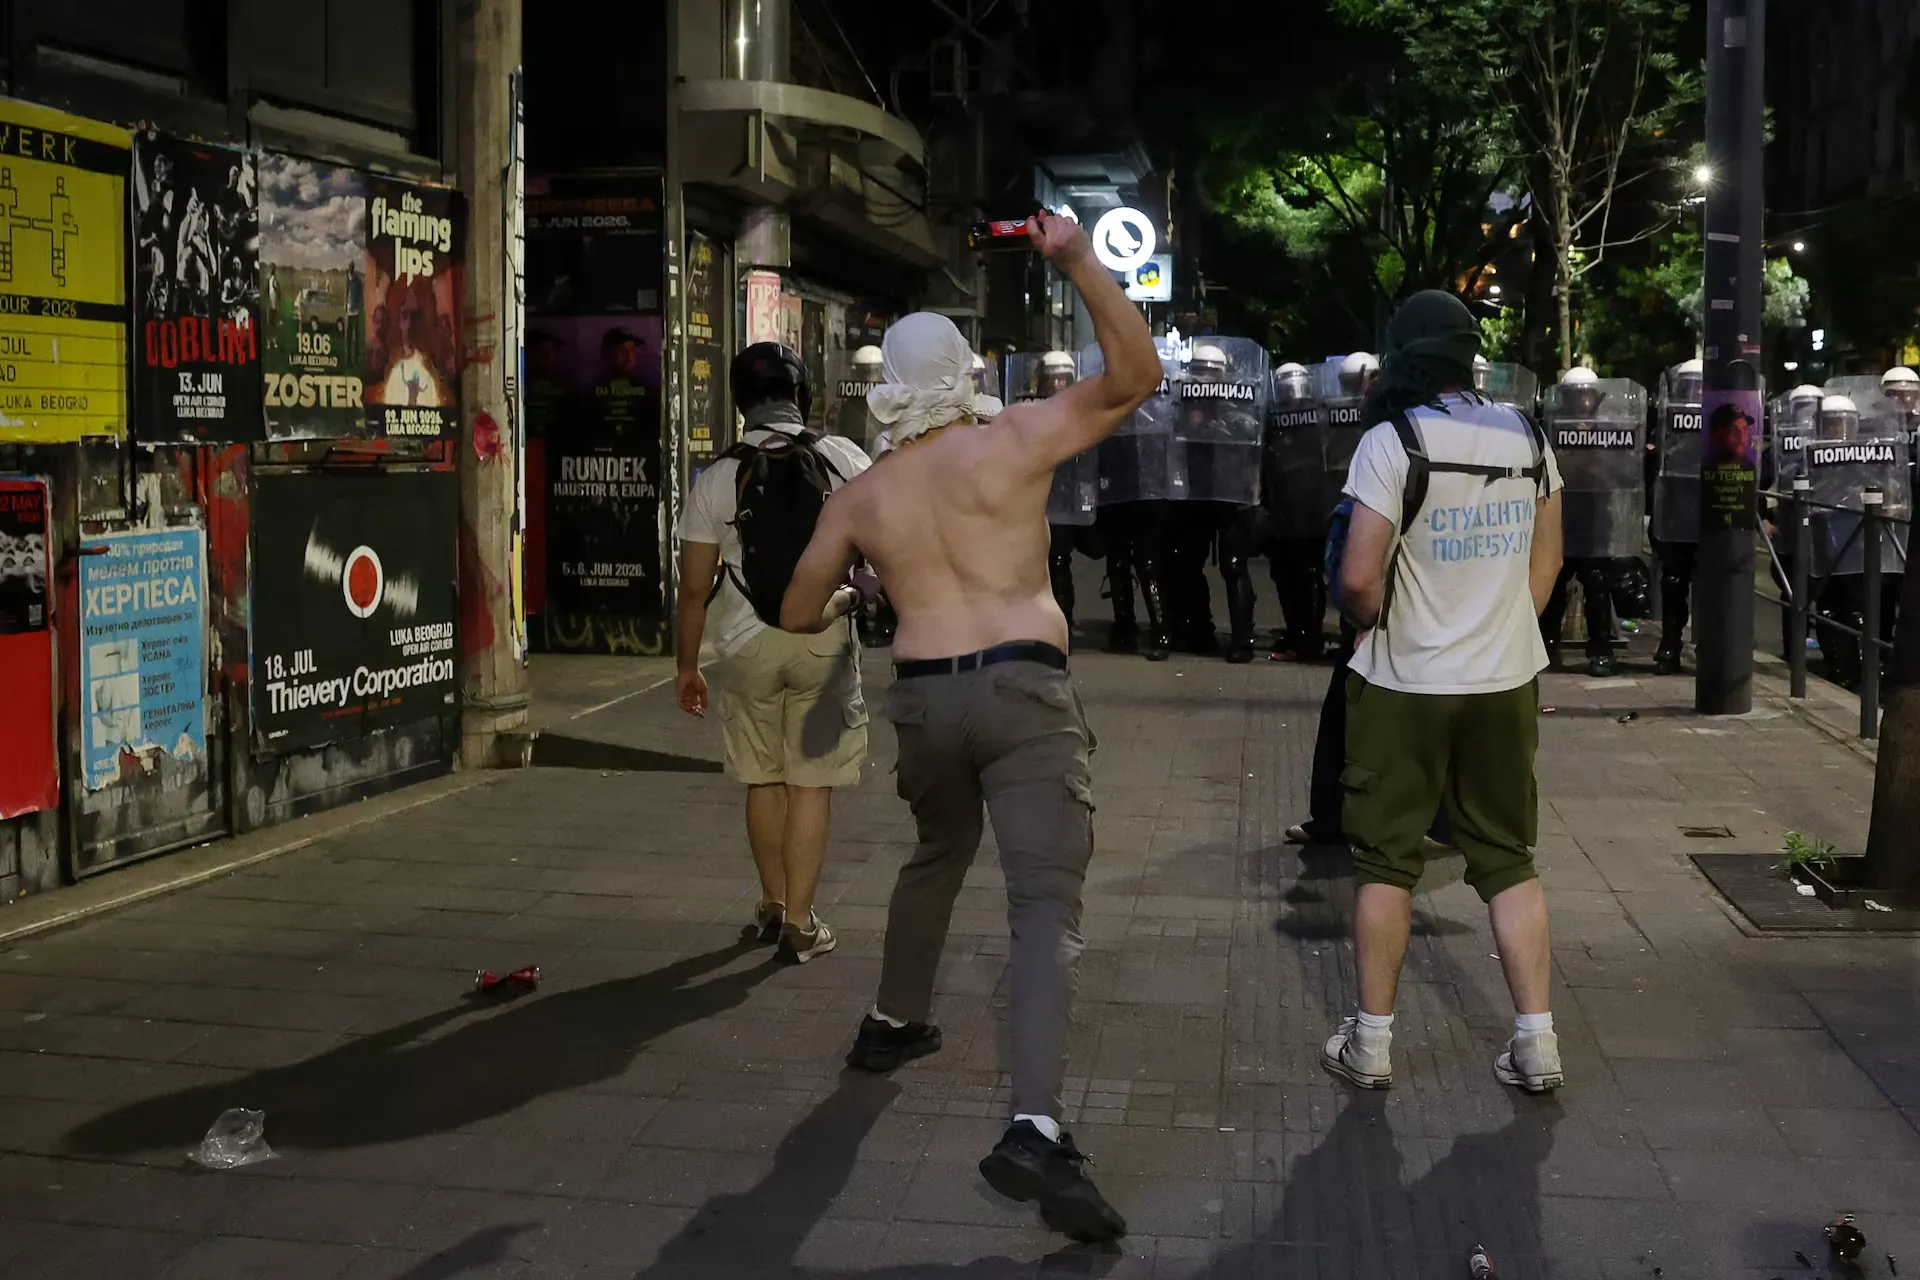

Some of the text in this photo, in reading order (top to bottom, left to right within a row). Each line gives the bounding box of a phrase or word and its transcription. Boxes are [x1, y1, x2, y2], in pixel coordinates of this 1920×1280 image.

[401, 191, 423, 214] the
[371, 197, 452, 253] flaming
[395, 237, 434, 288] lips
[41, 299, 77, 318] 2026
[0, 336, 32, 355] JUL
[145, 315, 257, 369] GOBLINI
[296, 332, 332, 355] 19.06
[177, 371, 223, 394] 13. JUN
[263, 372, 364, 408] ZOSTER
[1182, 383, 1254, 400] ПОЛИЦИЈА
[384, 408, 444, 425] 22. JUN 2026.
[1329, 408, 1361, 424] ПОЛ
[1673, 413, 1702, 429] ПОЛ
[1558, 430, 1634, 448] ПОЛИЦИЈА
[1813, 446, 1895, 464] ПОЛИЦИЈА
[561, 456, 647, 482] RUNDEK
[553, 482, 607, 498] HAUSTOR
[621, 483, 656, 498] EKIPA
[12, 494, 41, 512] MAY
[143, 556, 194, 578] против
[590, 562, 613, 577] JUN
[85, 575, 197, 618] ХЕРПЕСА
[389, 627, 414, 647] LUKA
[402, 643, 419, 657] OPEN
[418, 641, 430, 655] AIR
[264, 649, 318, 680] 18. JUL
[266, 655, 454, 714] Thievery Corporation
